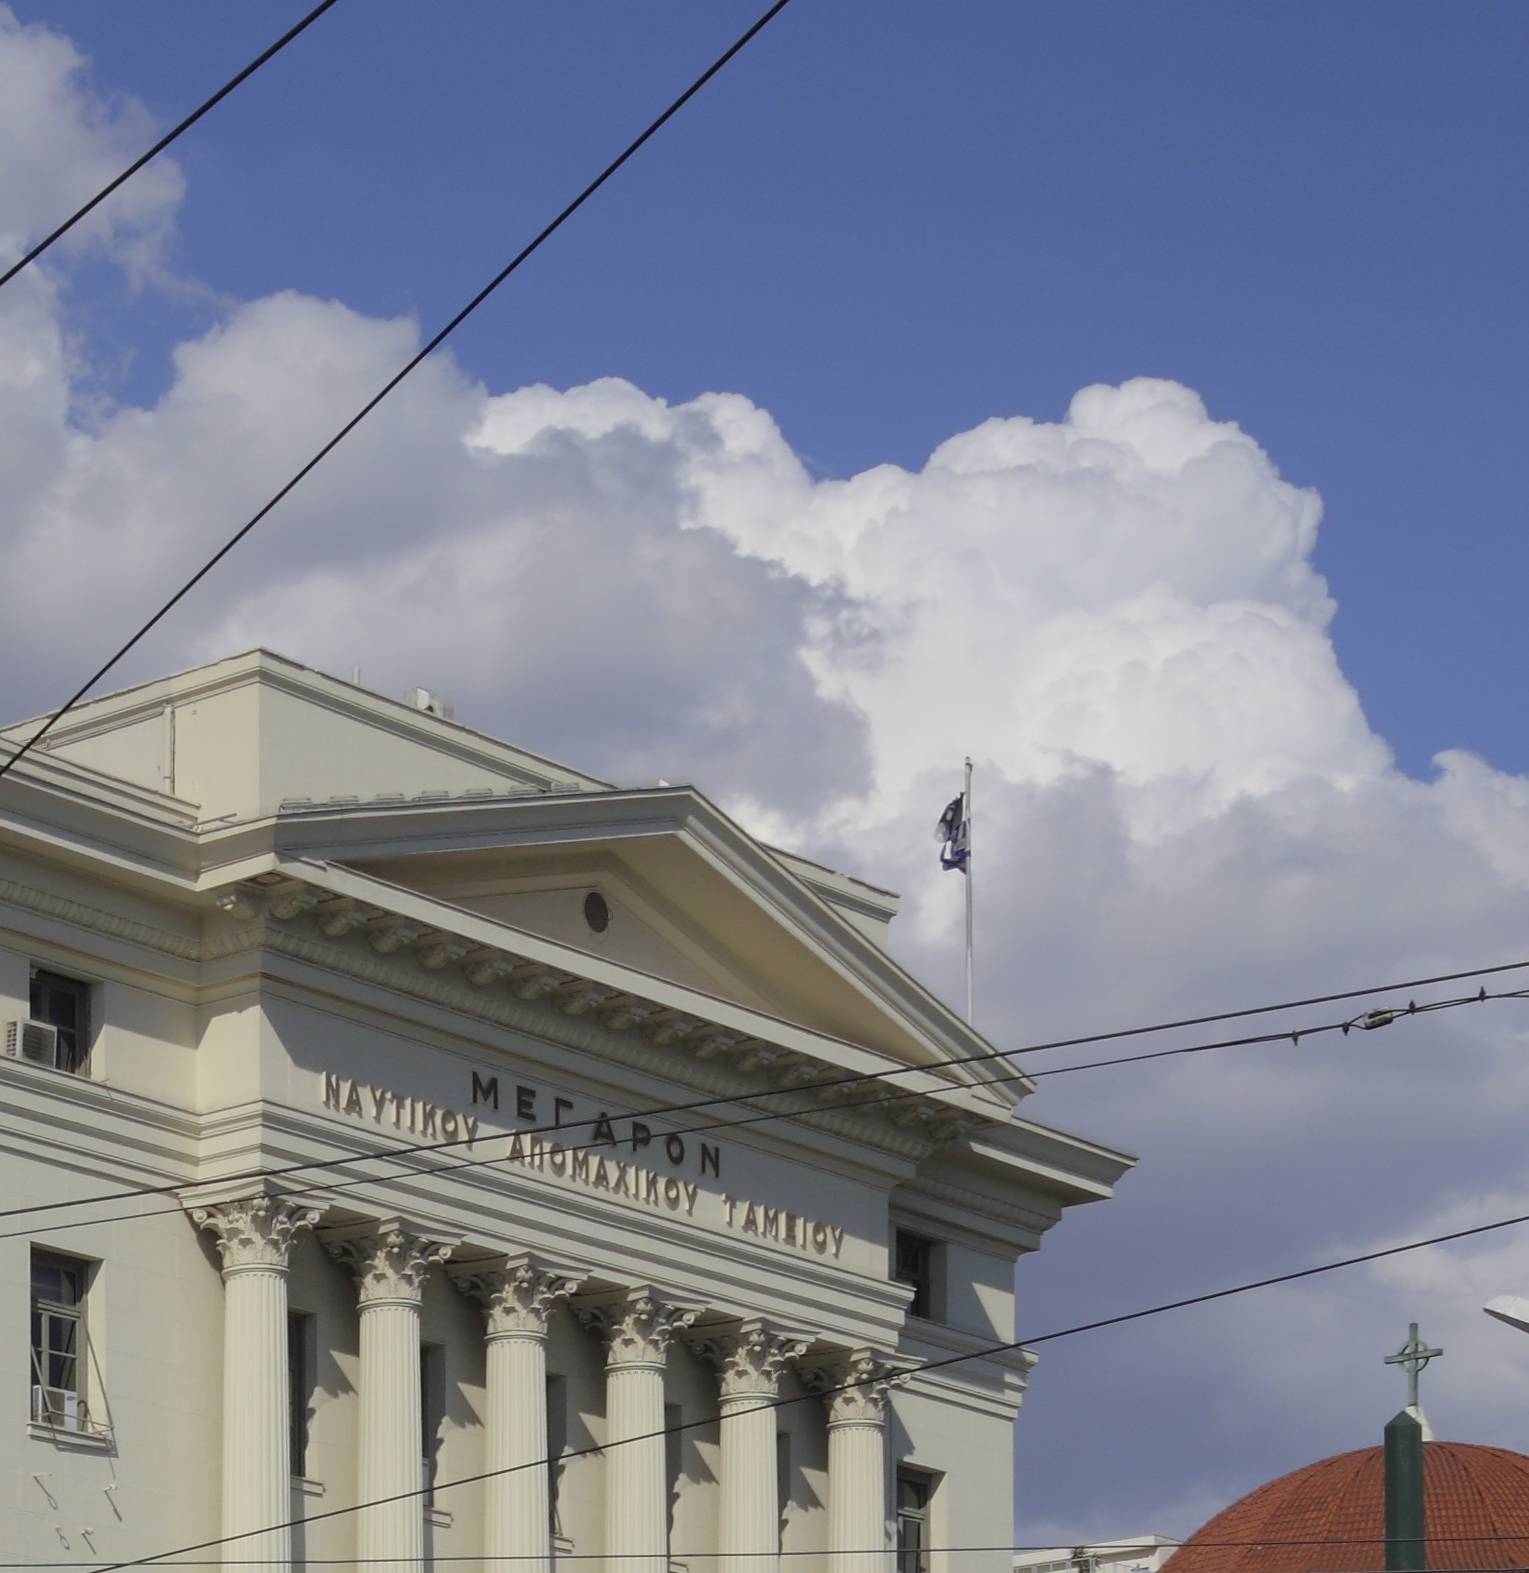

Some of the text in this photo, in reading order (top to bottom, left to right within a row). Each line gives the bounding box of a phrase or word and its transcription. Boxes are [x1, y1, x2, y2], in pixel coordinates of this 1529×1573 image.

[322, 1070, 845, 1260] ΝΑΥΤΙΚΟΥ ΑΠΟΜΑΧΙΚΟΥ ΤΑΜΕΙΟΥ
[472, 1070, 720, 1178] ΜΕΓΑΡΟΝ
